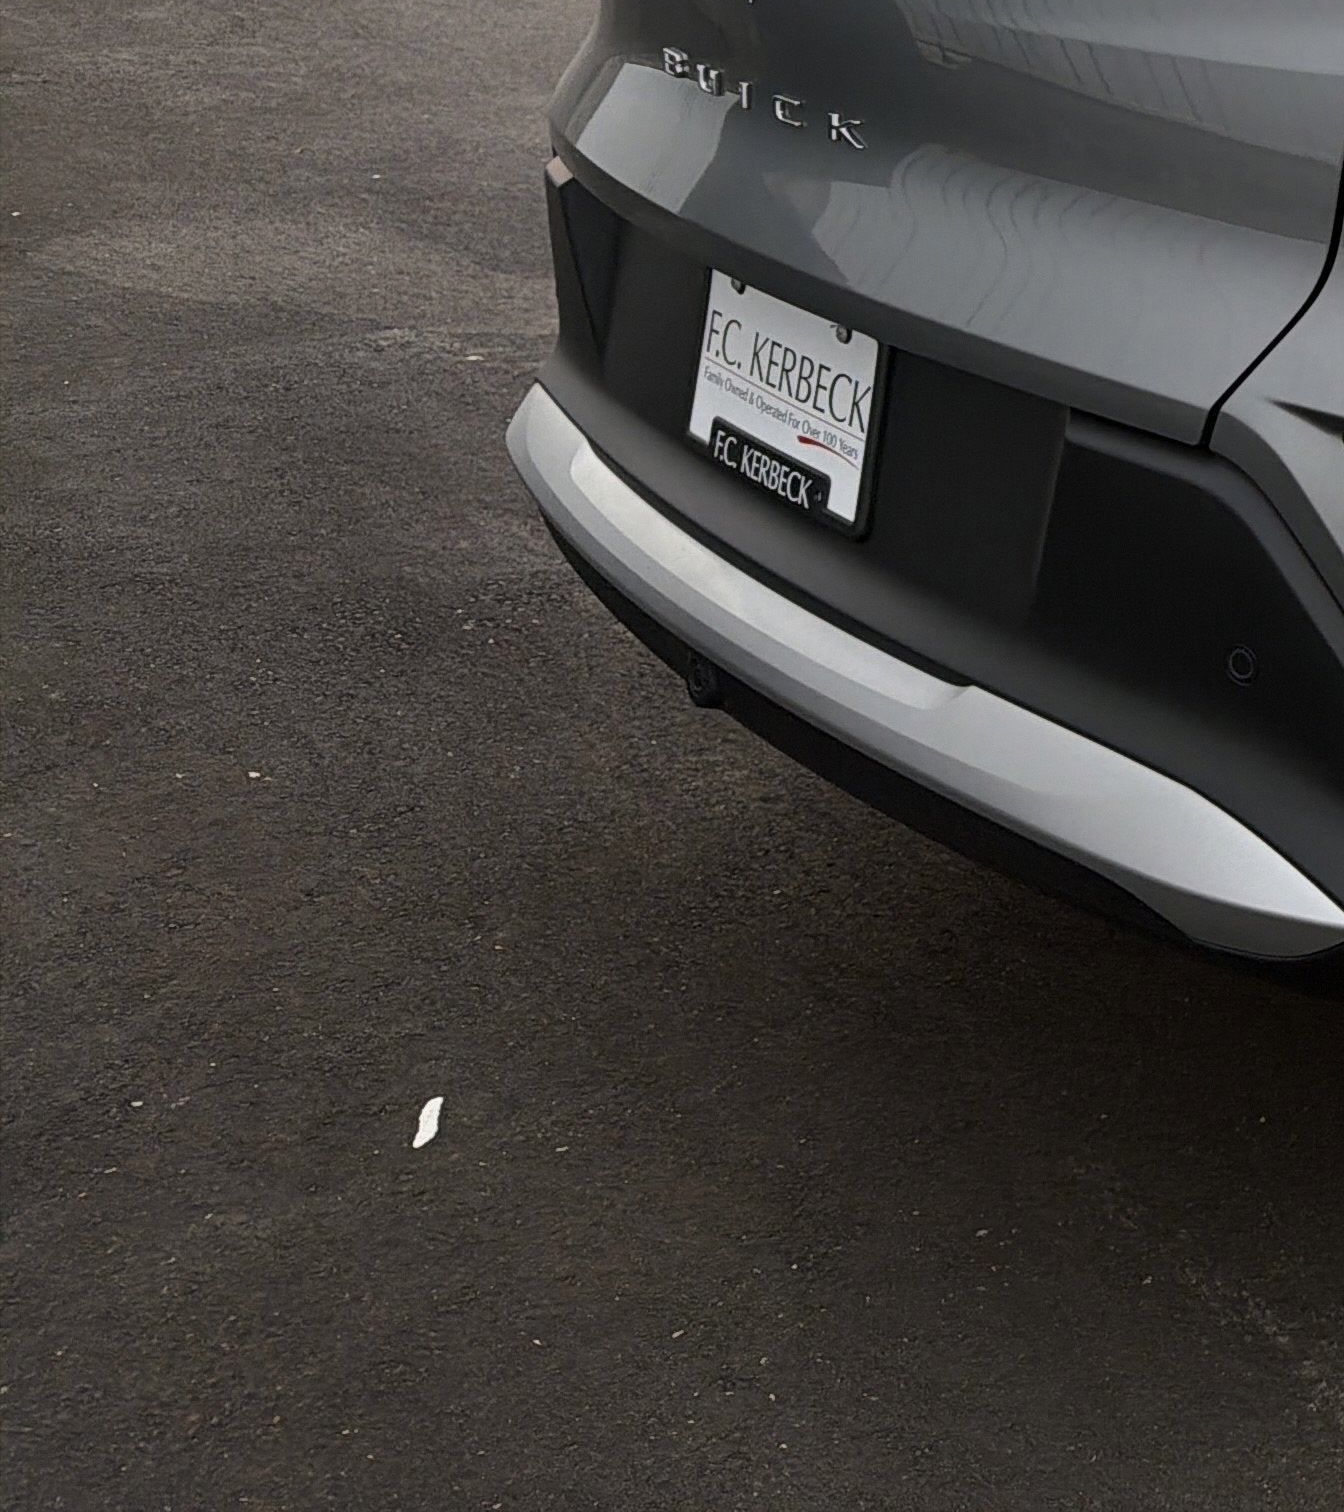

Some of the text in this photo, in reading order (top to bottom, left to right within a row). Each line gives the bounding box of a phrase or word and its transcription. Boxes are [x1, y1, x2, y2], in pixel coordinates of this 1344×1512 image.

[662, 46, 868, 150] BUICK
[704, 366, 724, 390] Family
[725, 378, 749, 402] Owned
[756, 395, 788, 423] Operated
[788, 412, 800, 430] For
[802, 419, 821, 440] Over
[823, 431, 837, 448] 100
[839, 438, 859, 461] Years
[706, 309, 872, 434] F.C. KERBECK
[713, 429, 813, 510] F.C. KERBECK
